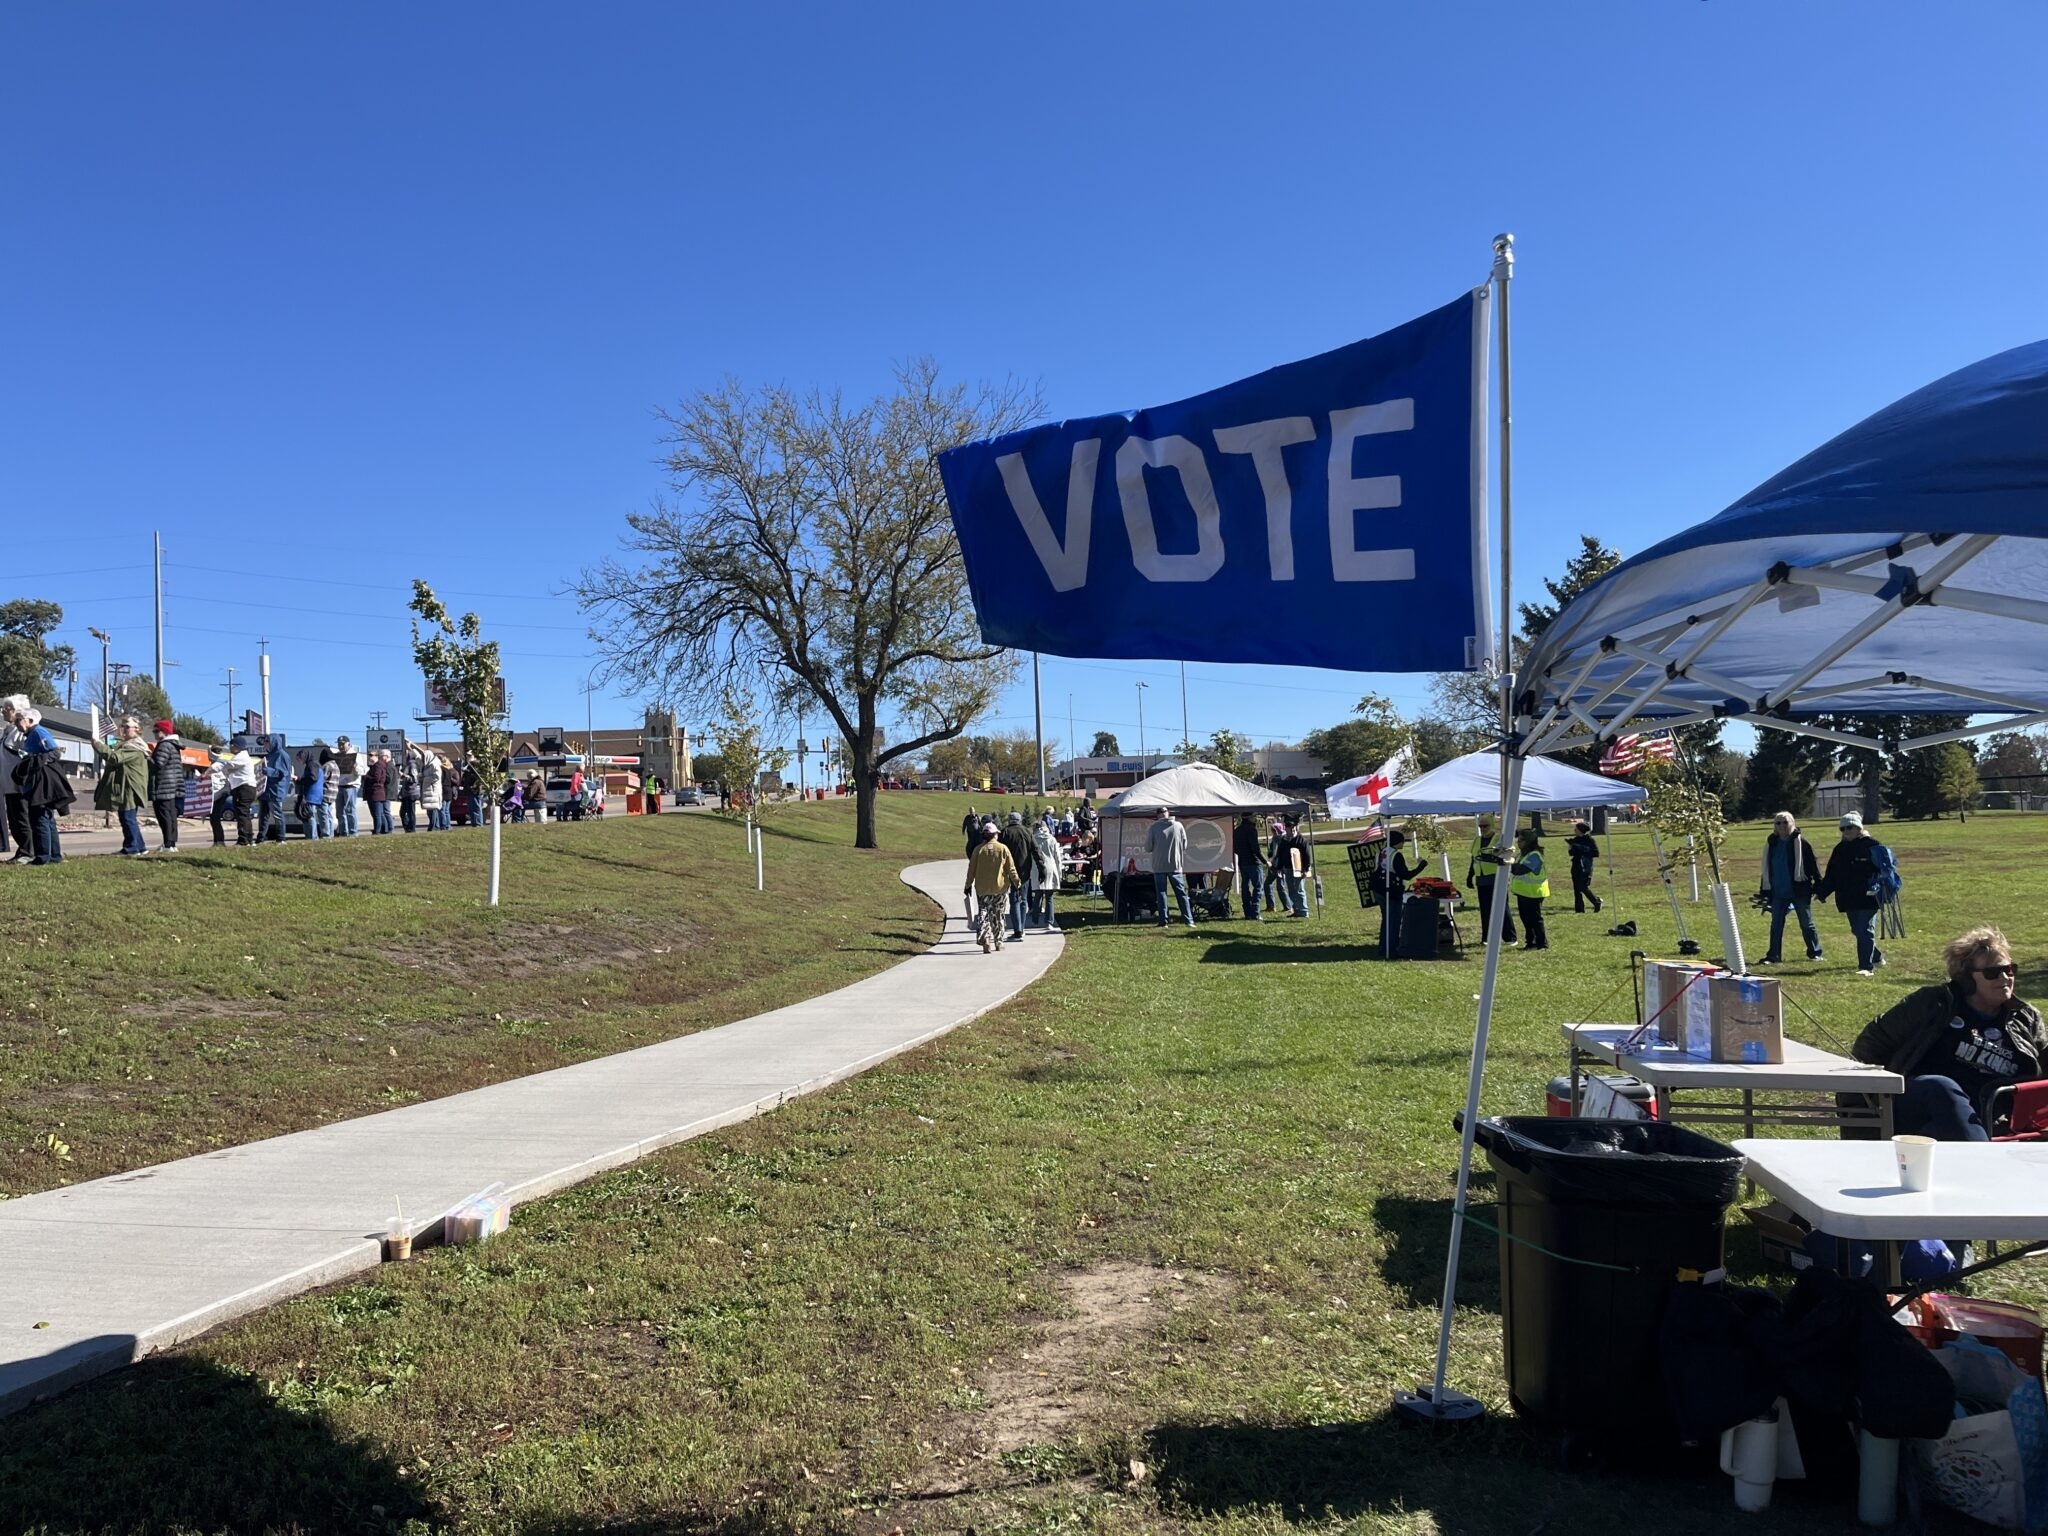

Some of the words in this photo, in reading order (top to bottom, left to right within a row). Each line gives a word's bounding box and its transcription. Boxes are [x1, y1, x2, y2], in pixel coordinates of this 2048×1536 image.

[995, 397, 1416, 592] VOTE
[1955, 1041, 1978, 1062] NO
[1977, 1049, 2019, 1075] KINGS
